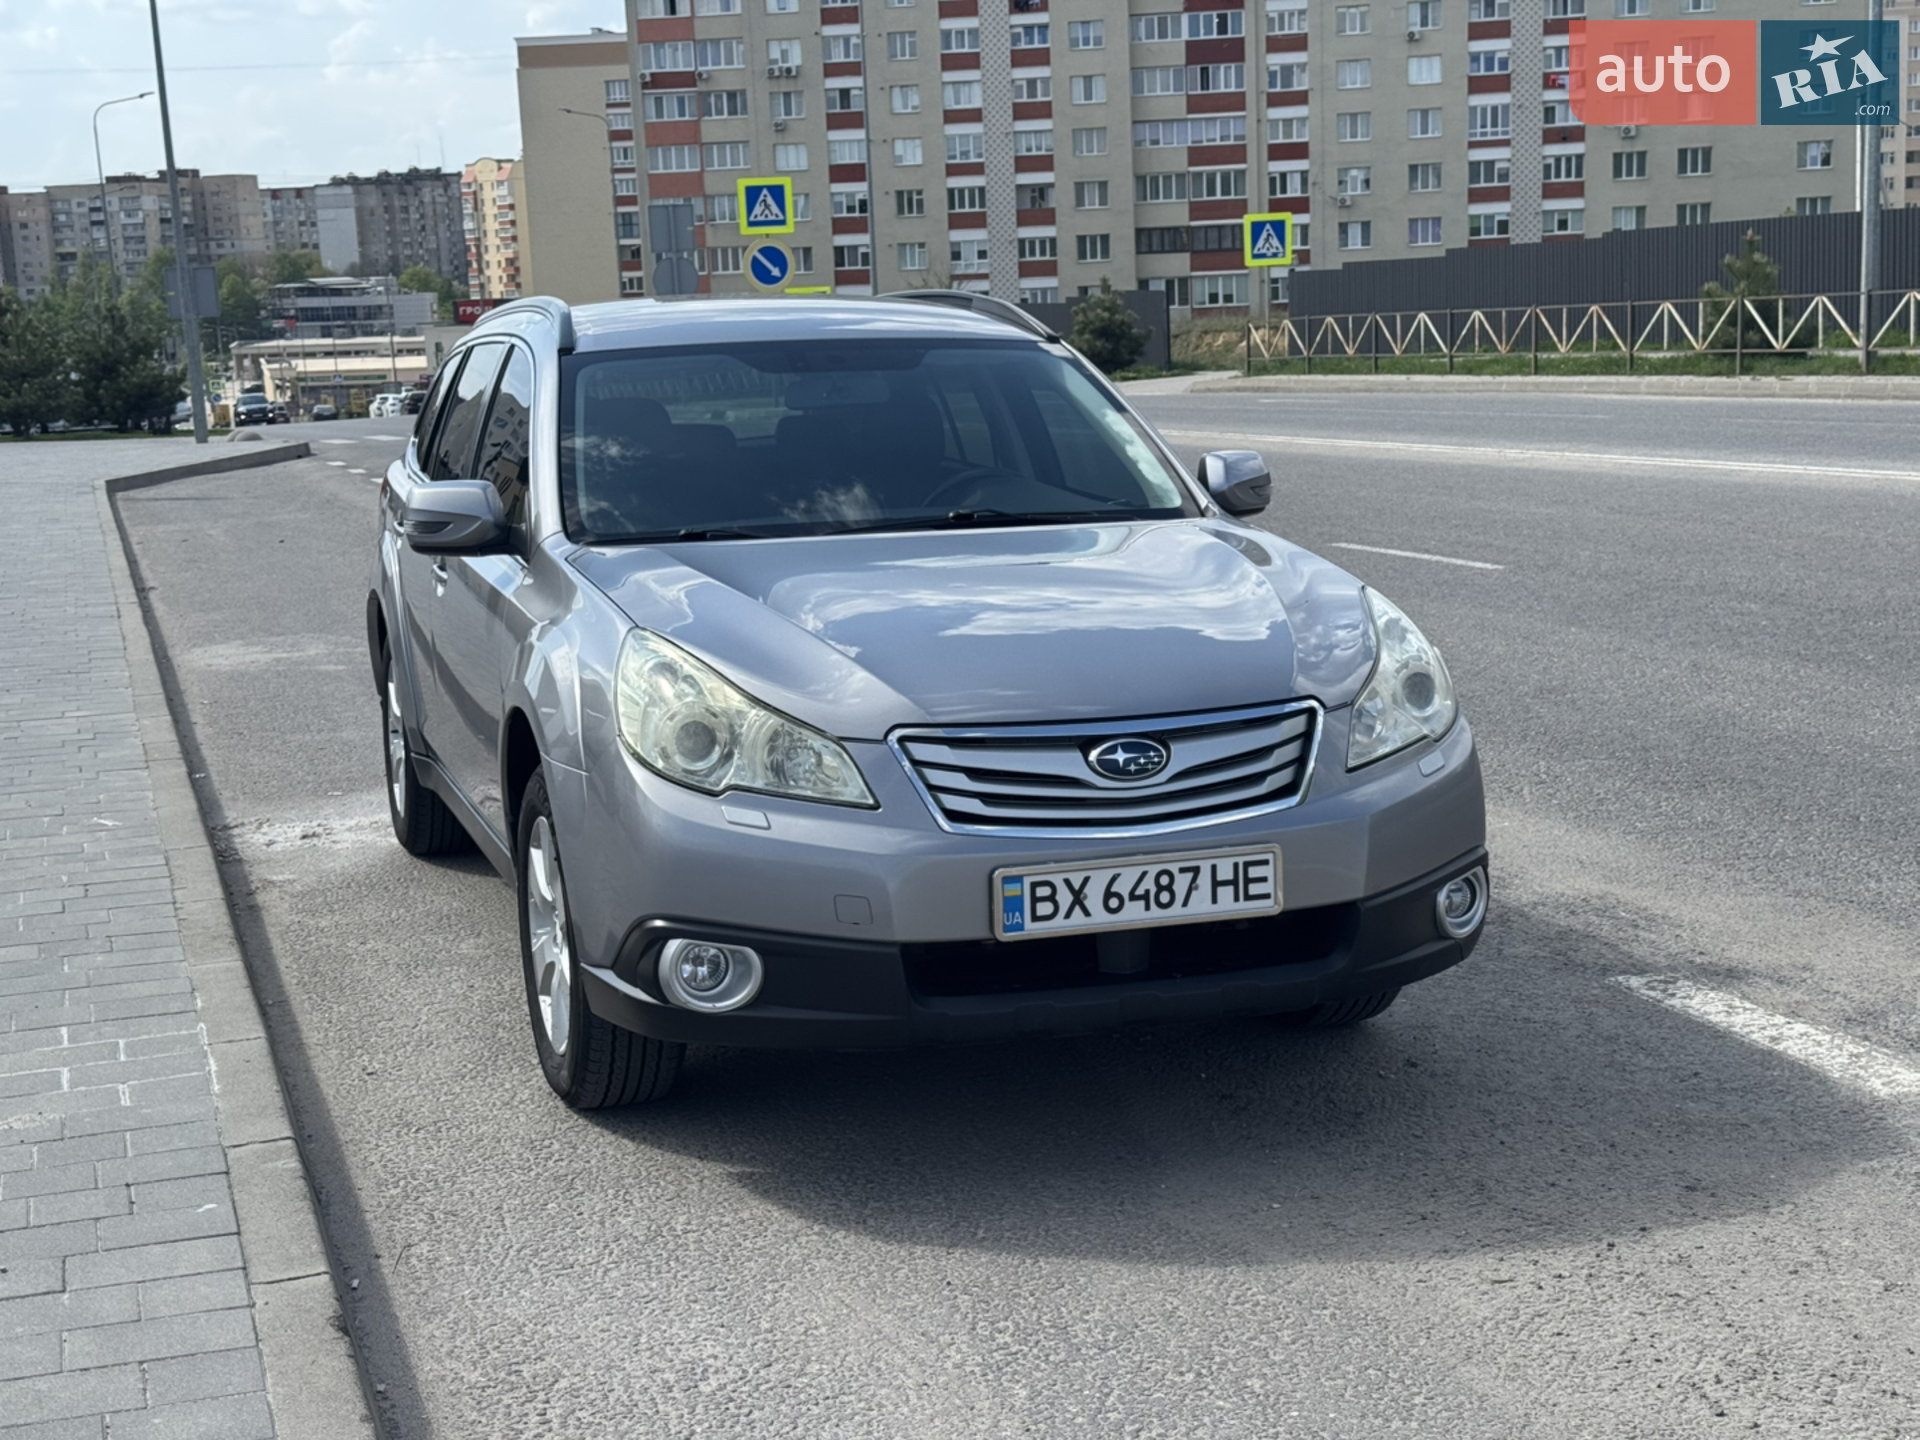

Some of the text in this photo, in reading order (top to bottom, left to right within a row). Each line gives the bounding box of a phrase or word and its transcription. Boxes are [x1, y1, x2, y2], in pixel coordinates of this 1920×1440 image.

[1029, 858, 1272, 923] BX 6487 HE
[1003, 911, 1023, 925] UA
